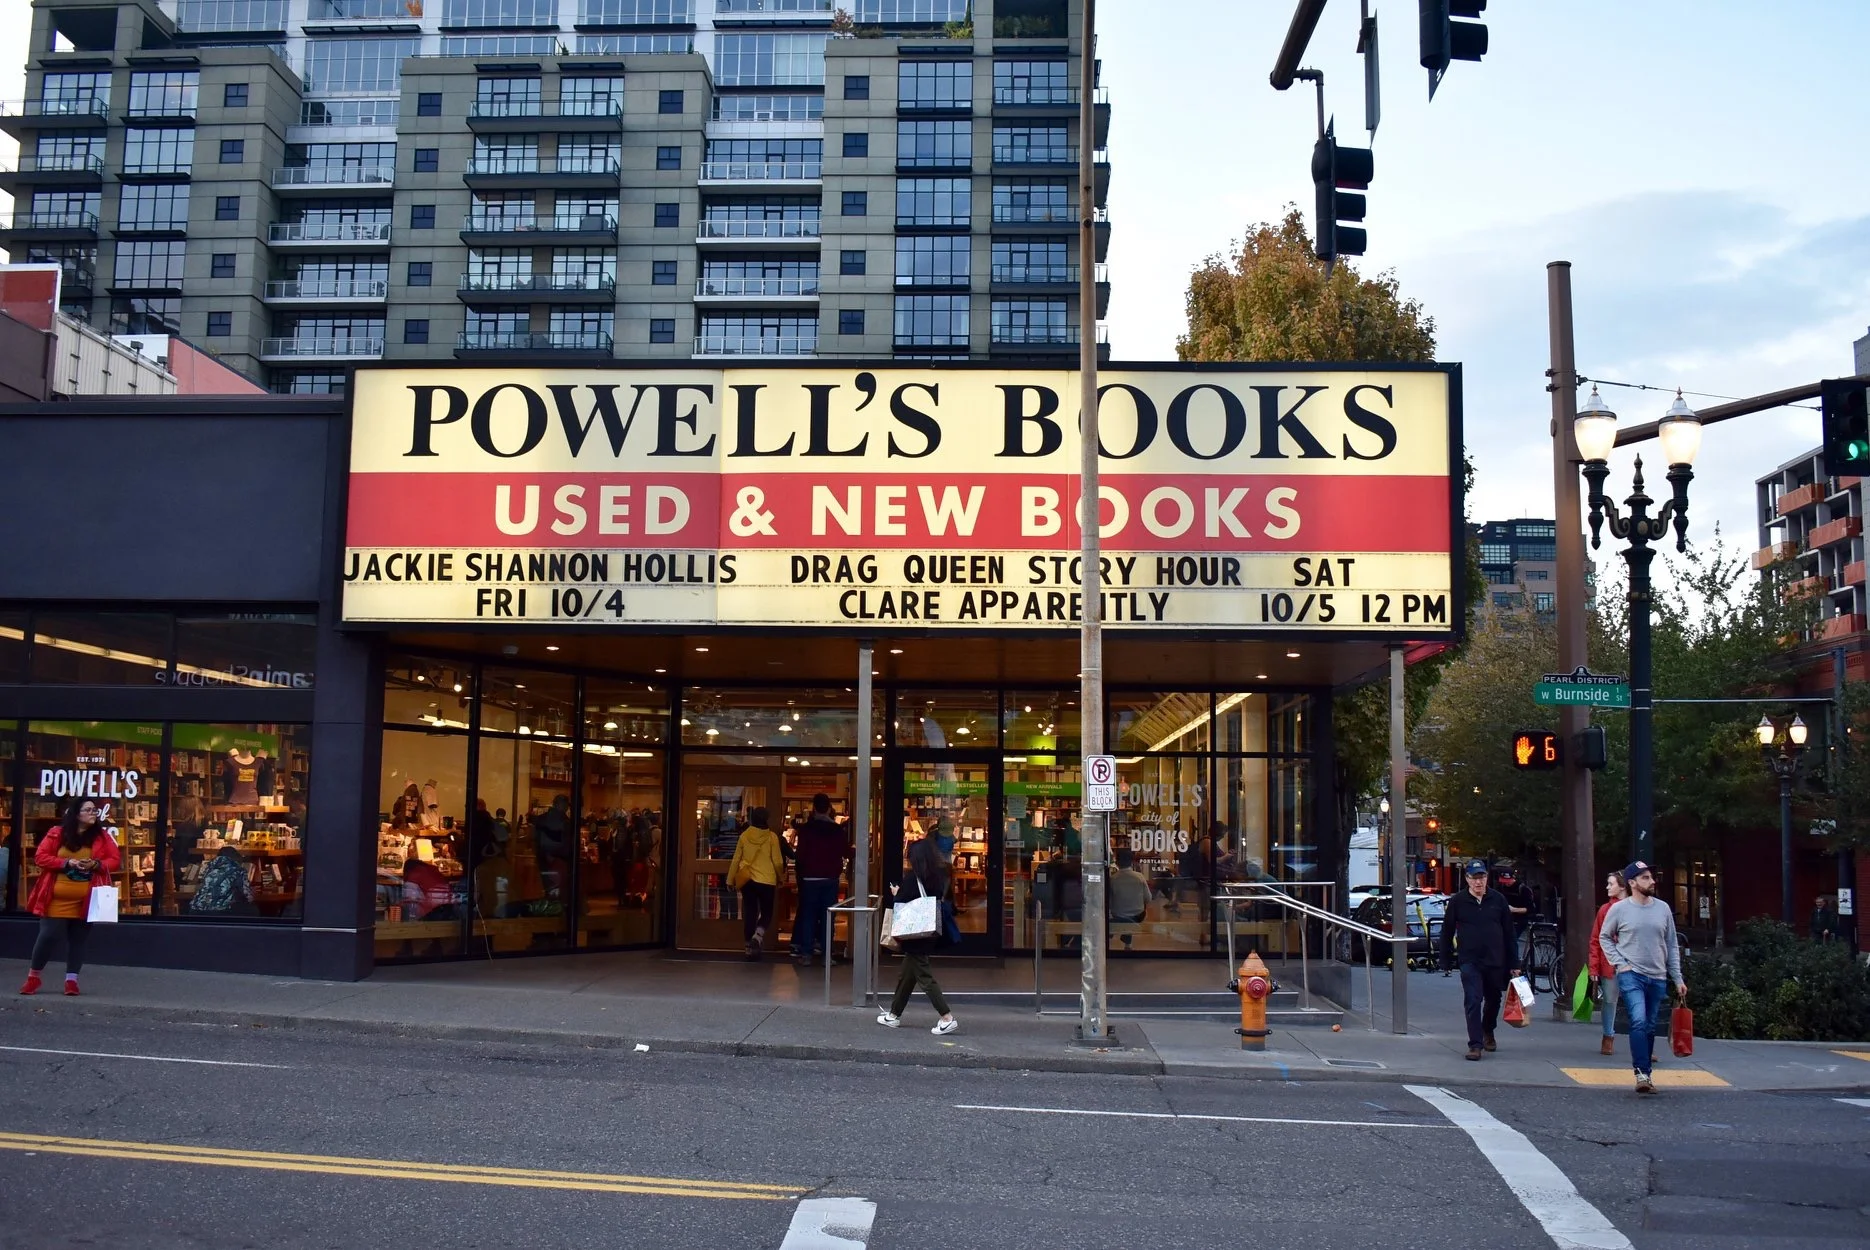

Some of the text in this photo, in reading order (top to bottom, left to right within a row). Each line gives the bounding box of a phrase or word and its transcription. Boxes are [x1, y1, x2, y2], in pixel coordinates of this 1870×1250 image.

[402, 371, 1397, 461] POWELL'S BOOKS
[495, 484, 1301, 540] USED & NEW BOOKS
[343, 553, 737, 584] JACKIE SHANNON HOLLIS
[791, 554, 1356, 587] DRAG QUEEN STORY HOUR SAT
[476, 588, 625, 618] FRI 10/4
[839, 590, 1170, 622] CLARE APPARETLY
[1261, 593, 1446, 623] 10/5 12 PM
[1544, 676, 1620, 685] PEARL DISTRICT
[1555, 688, 1610, 701] Burnside
[1545, 737, 1555, 761] 6
[40, 769, 139, 799] POWELL'S
[1095, 787, 1110, 796] THIS
[1118, 783, 1203, 807] POWELL'S
[1091, 796, 1113, 806] BLOCK
[1140, 811, 1180, 826] city of
[1130, 829, 1189, 853] BOOKS
